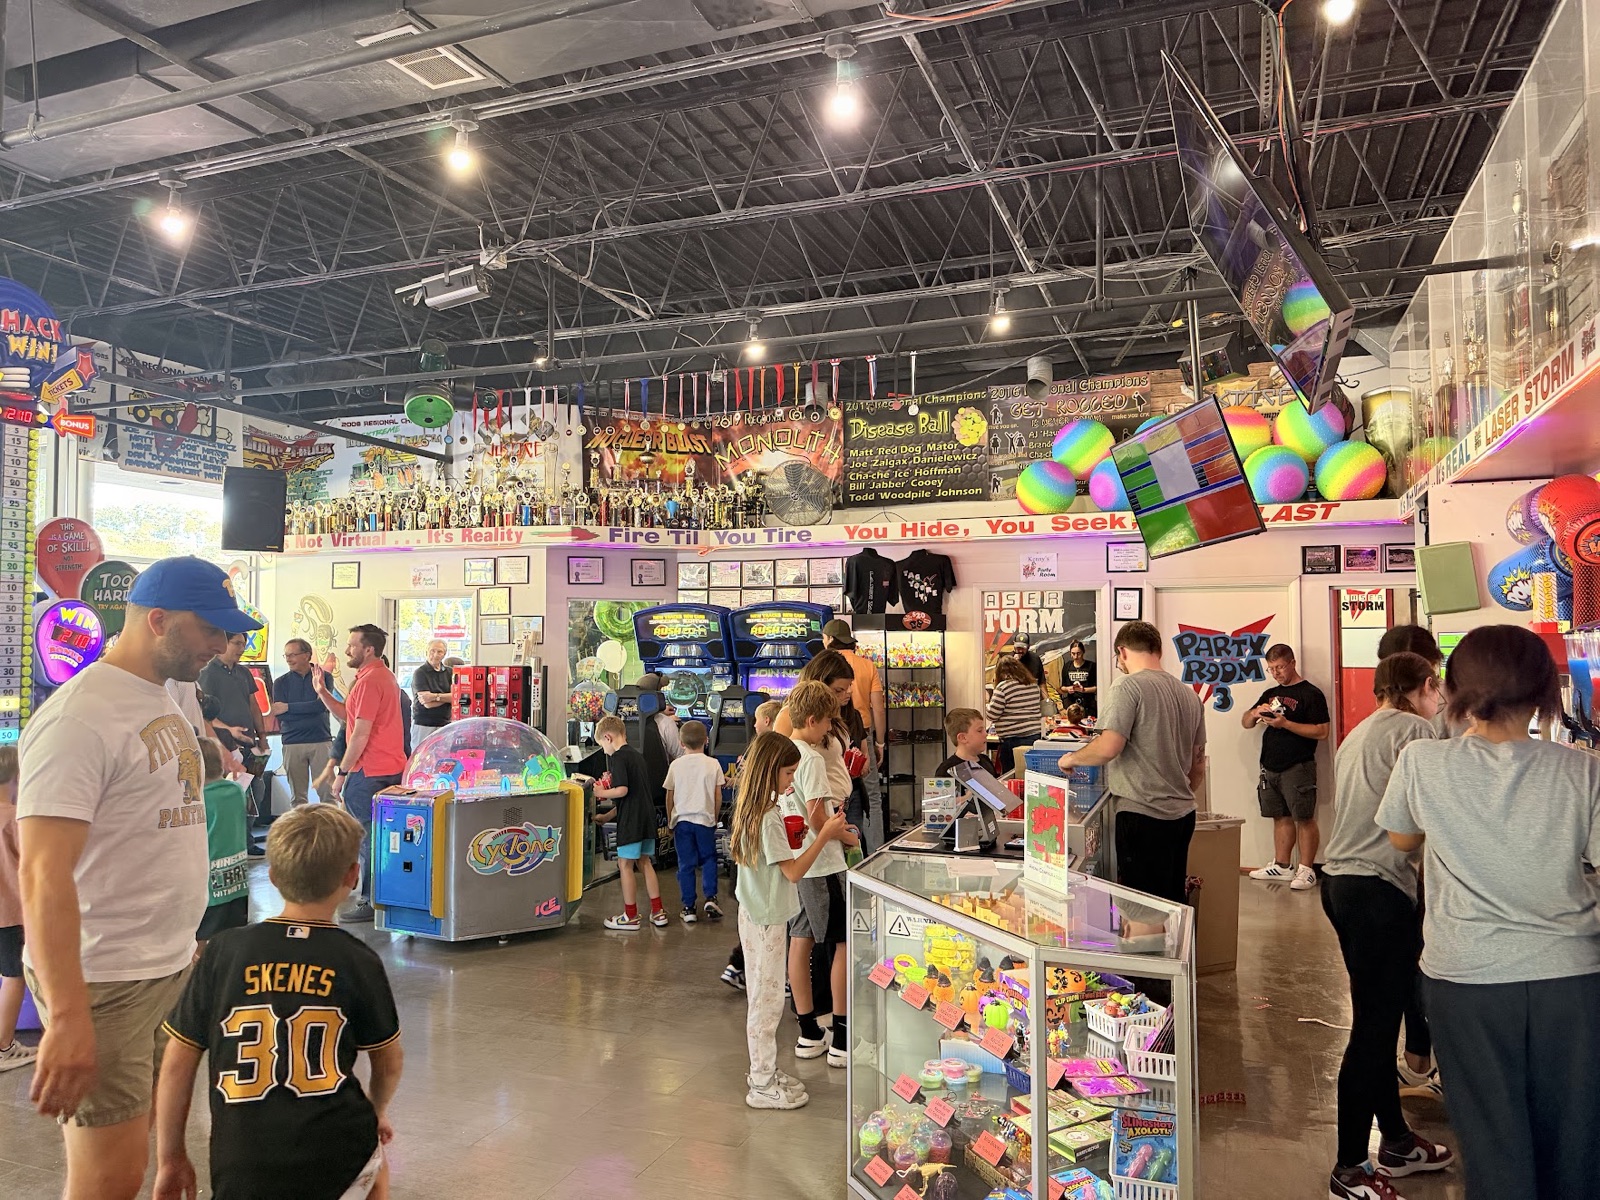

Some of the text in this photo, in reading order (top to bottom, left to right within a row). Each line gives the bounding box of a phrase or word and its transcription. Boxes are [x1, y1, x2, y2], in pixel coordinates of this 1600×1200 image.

[47, 376, 74, 397] TICKETS
[990, 375, 1149, 400] 2016 Champions
[874, 391, 987, 410] Regonal Champions
[1010, 400, 1048, 420] GET
[1446, 438, 1471, 479] REAL
[1485, 393, 1520, 447] LASER
[1524, 342, 1575, 415] STORM
[59, 418, 90, 431] BONUS
[848, 410, 951, 440] Disease Ball
[667, 433, 712, 455] BLAST
[714, 428, 842, 471] MONOLITH
[850, 448, 874, 458] Matt
[927, 442, 958, 452] Mator
[850, 460, 868, 469] Joe
[913, 453, 978, 465] Danielewicz
[914, 467, 962, 477] Hoffman
[849, 493, 875, 502] Todd
[936, 487, 983, 497] Johnson
[850, 482, 865, 491] Bill
[911, 479, 944, 488] Cooey
[60, 523, 75, 531] THIS
[609, 528, 660, 544] Fire
[714, 530, 756, 545] You
[763, 528, 812, 543] Tire
[844, 525, 888, 540] You
[900, 521, 970, 538] Hide,
[986, 517, 1035, 535] You
[1258, 502, 1341, 523] LAST
[63, 532, 85, 540] GAME
[296, 528, 523, 549] Not Virtual It's Reality
[8, 542, 18, 550] 25
[47, 540, 91, 553] OF SKILL!
[100, 573, 132, 589] TOO
[984, 591, 1064, 608] ASER
[1341, 601, 1385, 611] STORM
[1542, 575, 1555, 618] POPCORN
[60, 607, 98, 631] WIN
[984, 608, 1065, 634] TORM
[654, 626, 681, 636] RUSH
[750, 626, 780, 635] RUSH
[1172, 629, 1271, 662] PARTY
[782, 669, 800, 678] NO
[1181, 658, 1267, 685] ROOM
[1213, 684, 1234, 712] 3
[472, 830, 557, 867] Cyclone
[534, 897, 561, 917] ICE
[244, 962, 336, 997] SKENES
[216, 1003, 349, 1104] 30
[1122, 1114, 1174, 1129] SLINGSHOT
[1127, 1127, 1171, 1140] AXOLOTL
